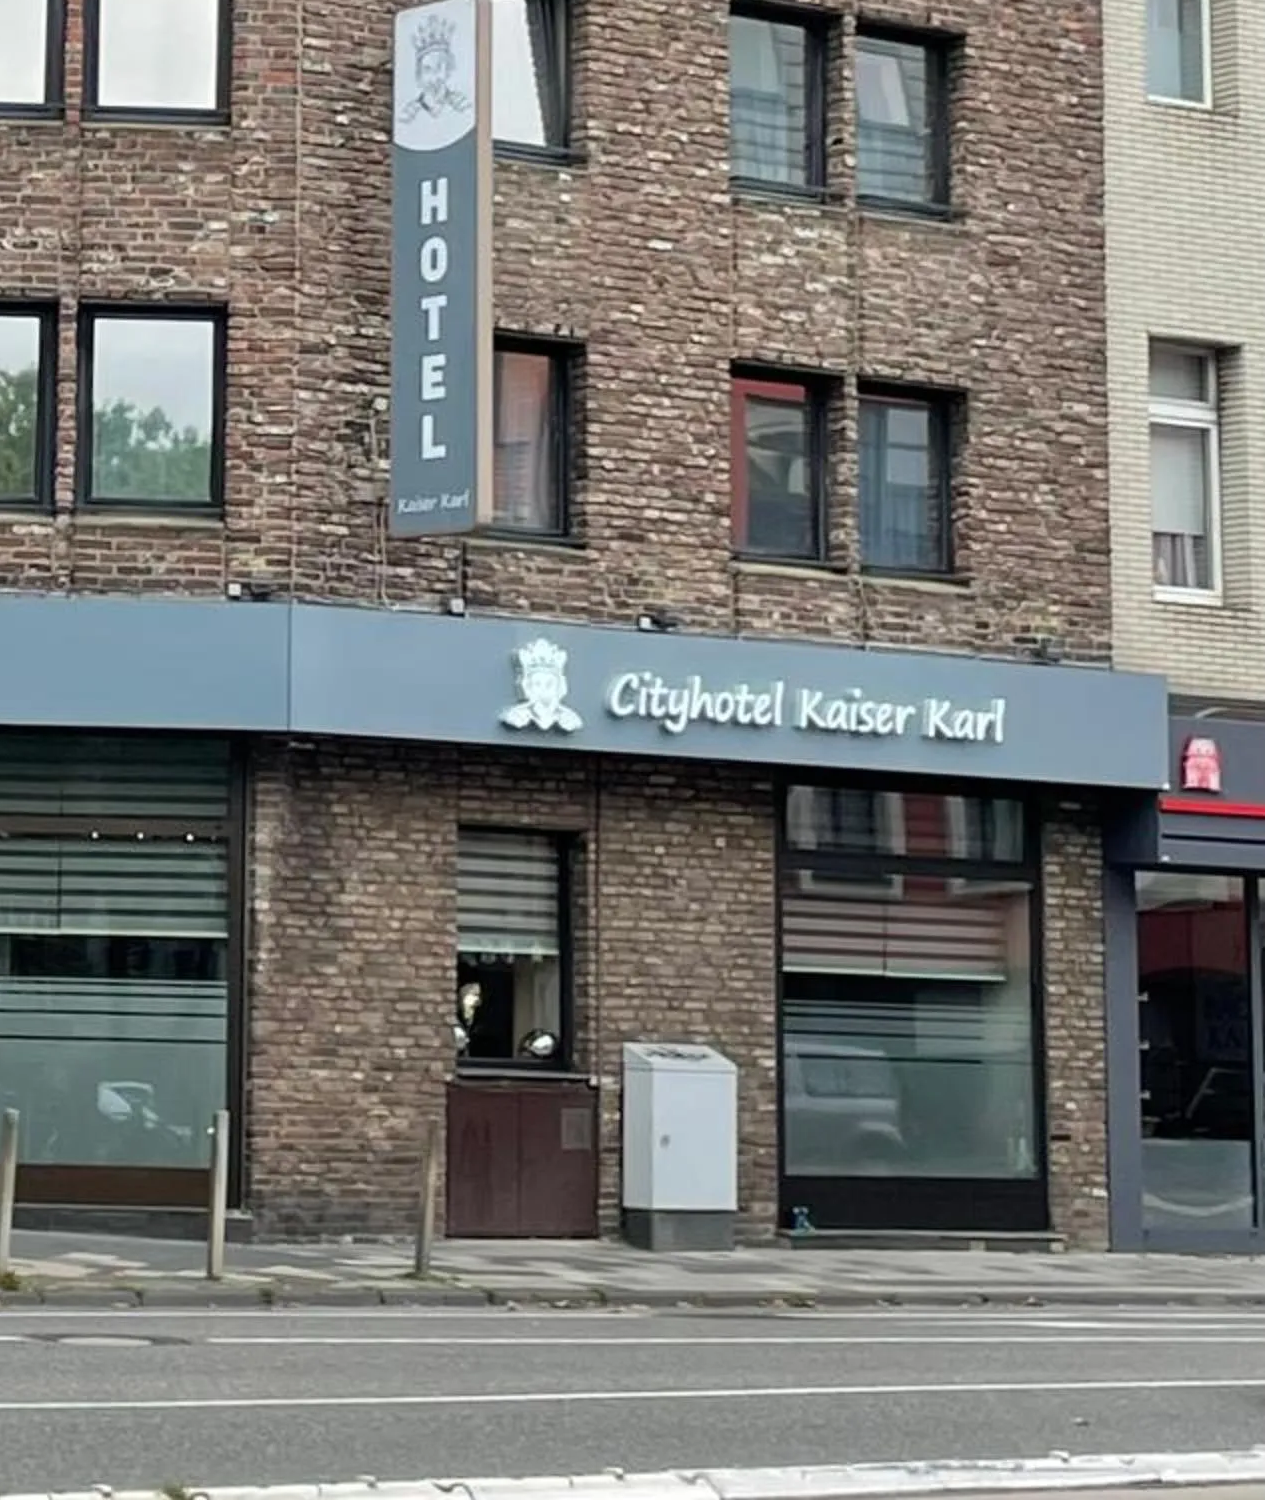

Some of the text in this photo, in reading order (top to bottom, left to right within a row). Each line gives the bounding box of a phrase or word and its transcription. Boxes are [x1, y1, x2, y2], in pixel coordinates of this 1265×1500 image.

[420, 177, 449, 461] HOTEL
[397, 488, 471, 514] Kaiser Karl
[604, 671, 1006, 743] Cityhotel Kaiser Karl
